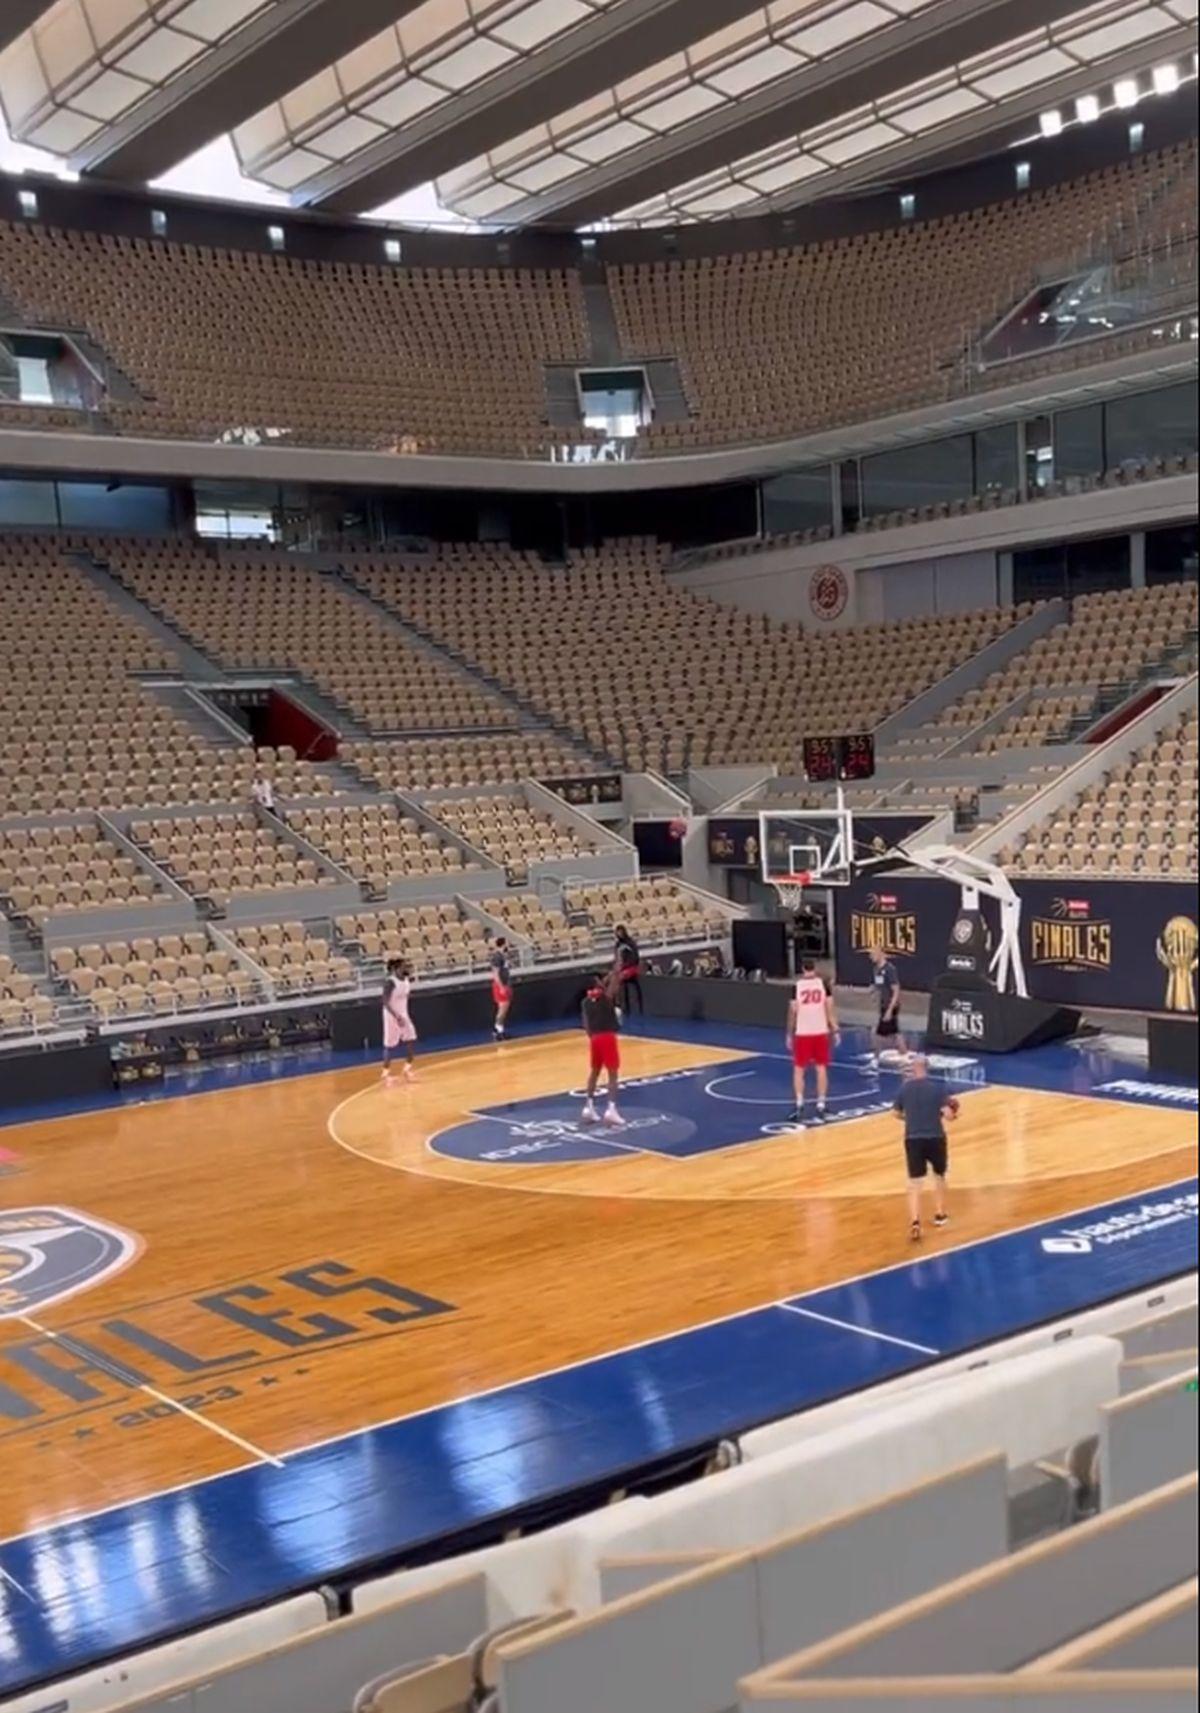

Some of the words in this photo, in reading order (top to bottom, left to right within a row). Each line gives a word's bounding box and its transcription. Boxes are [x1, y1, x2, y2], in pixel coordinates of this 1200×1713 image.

[851, 913, 916, 952] FINALES
[1032, 920, 1111, 964] FINALES
[801, 989, 823, 1004] 20
[0, 1259, 458, 1419] ALES
[113, 1385, 243, 1428] 2023
